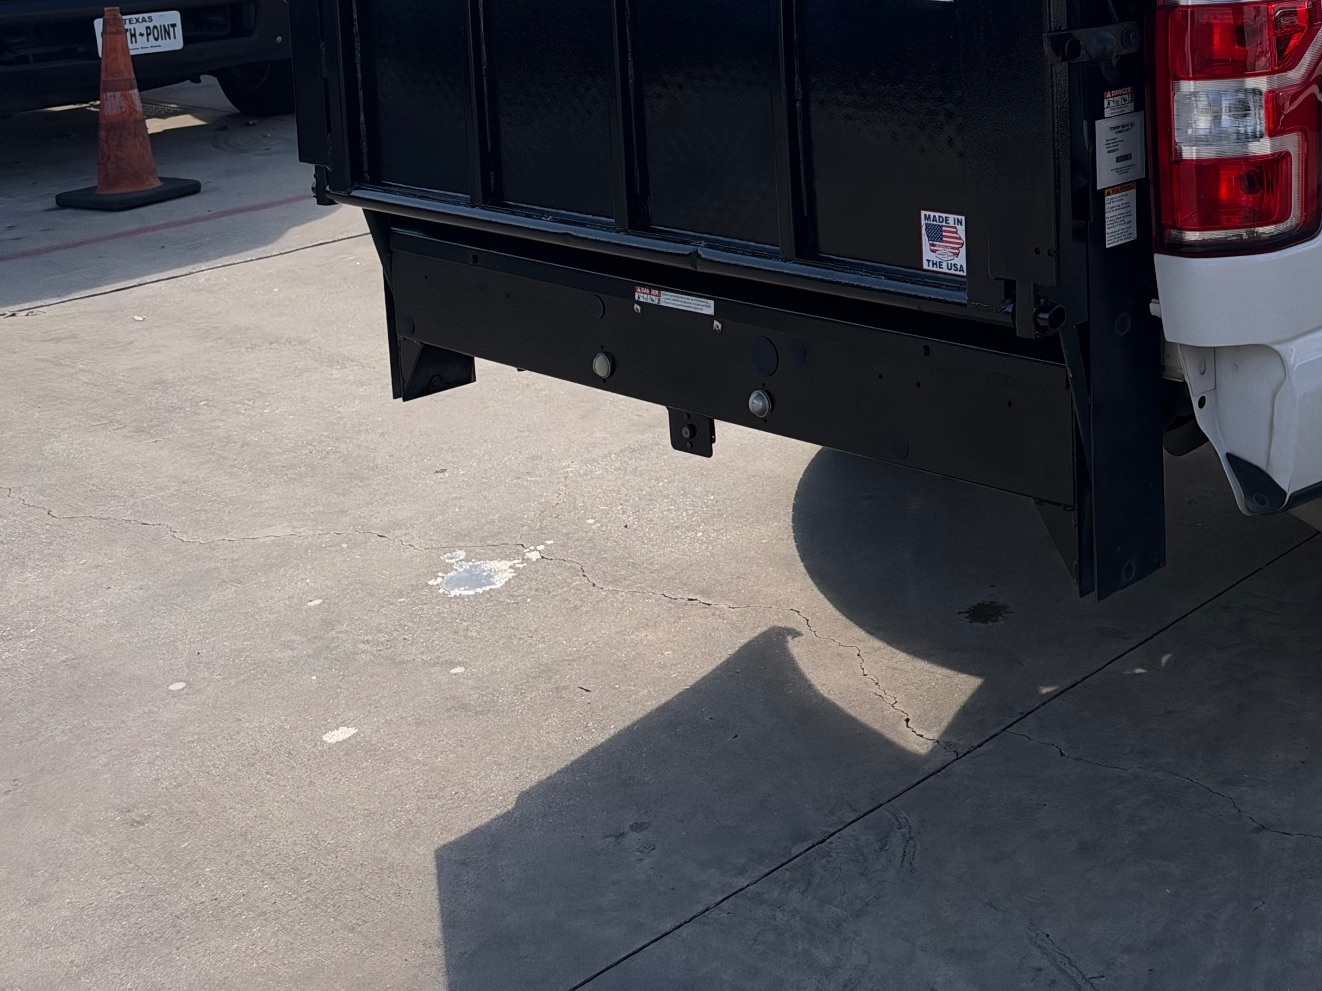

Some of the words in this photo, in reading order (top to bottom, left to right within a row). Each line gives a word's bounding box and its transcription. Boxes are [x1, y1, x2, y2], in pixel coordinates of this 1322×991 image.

[123, 16, 153, 26] TEXAS
[924, 213, 950, 225] MADE
[953, 217, 963, 226] IN
[926, 259, 943, 269] THE
[946, 262, 965, 273] USA
